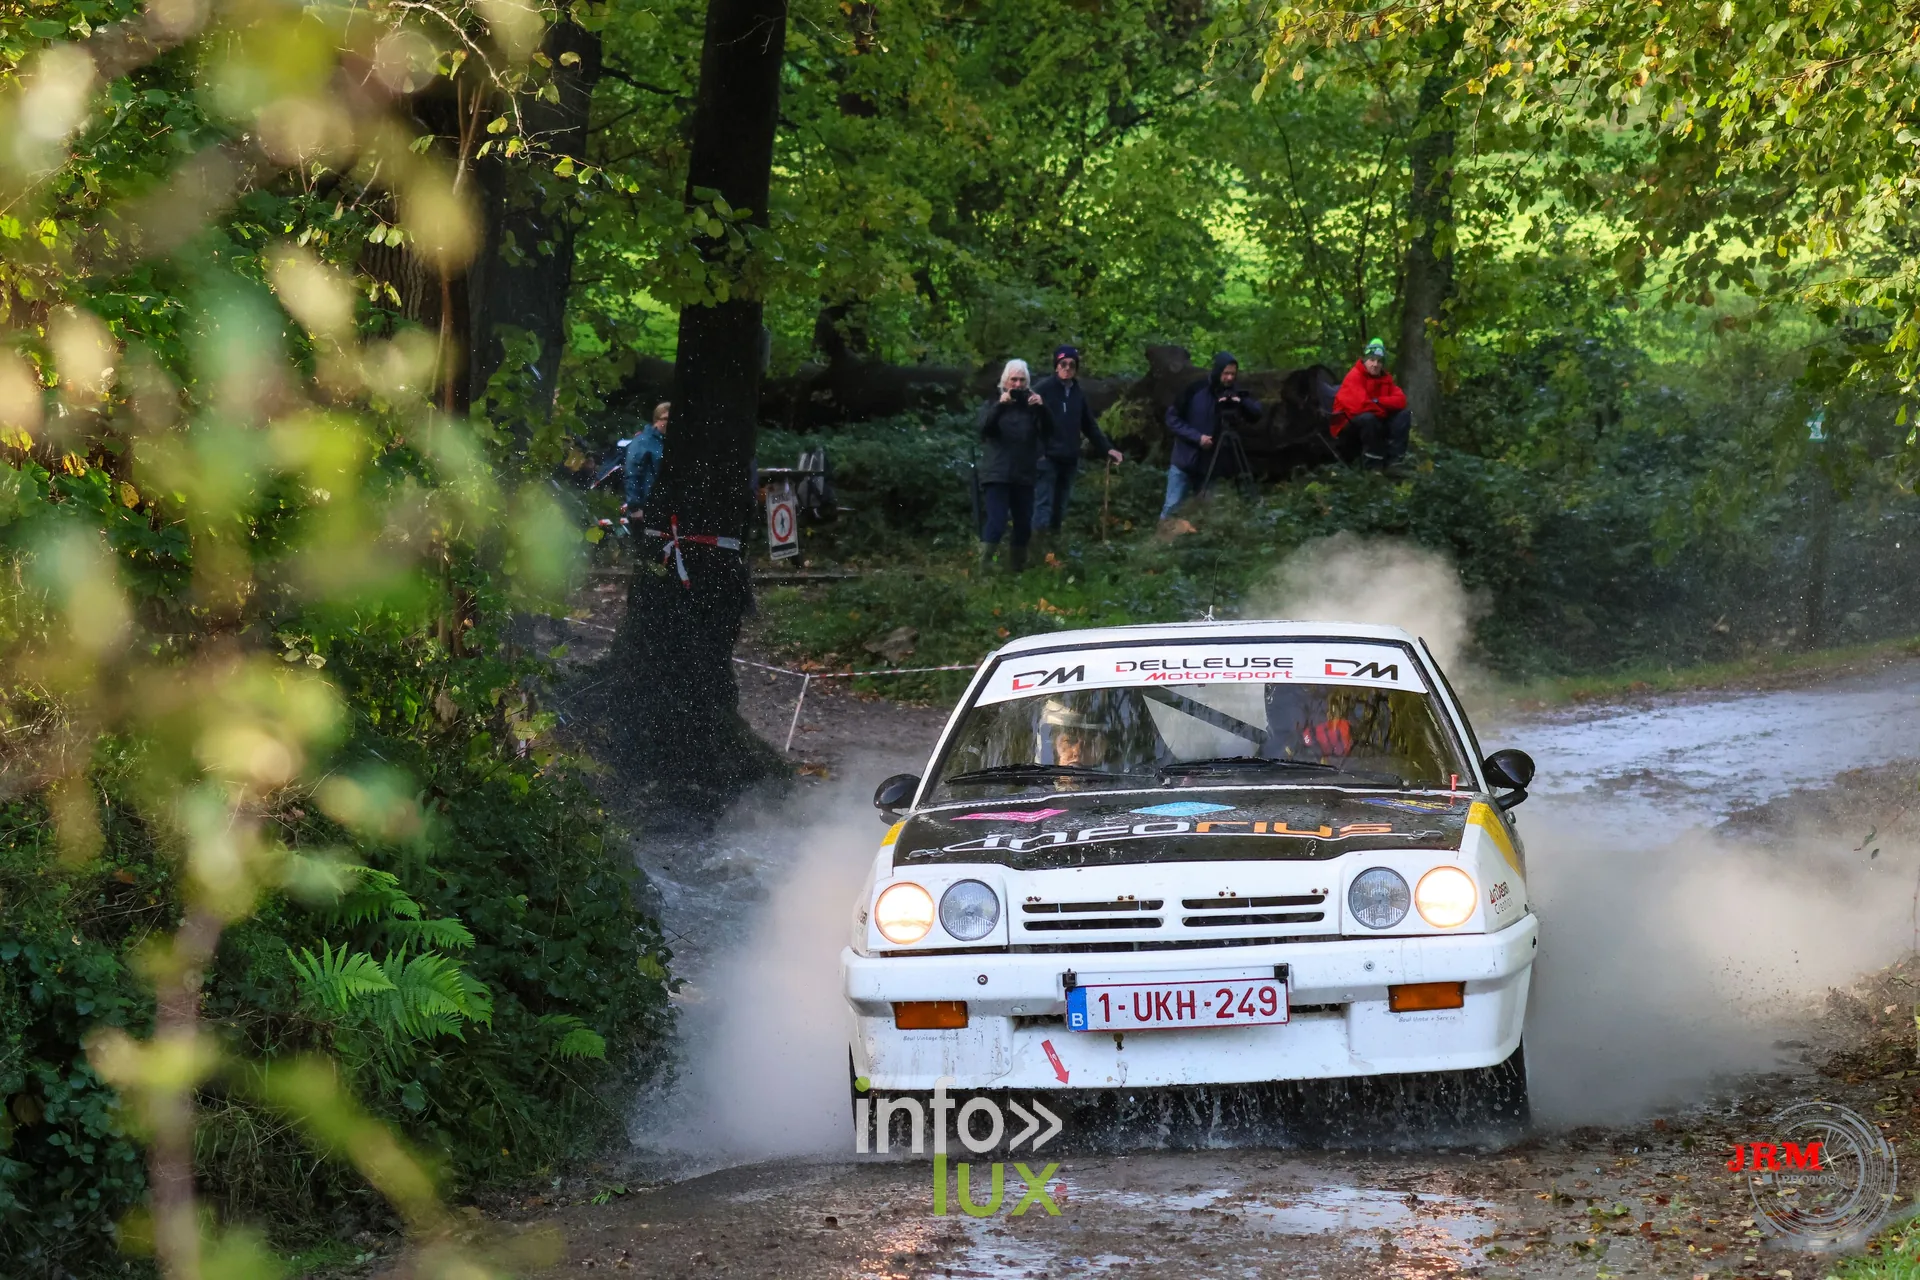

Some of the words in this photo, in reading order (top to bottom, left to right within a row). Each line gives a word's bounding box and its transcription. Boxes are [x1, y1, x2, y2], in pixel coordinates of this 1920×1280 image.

[1115, 657, 1294, 673] DELLEUSE
[1325, 658, 1398, 681] DM
[1012, 665, 1085, 690] DM
[1144, 670, 1293, 681] Motorsport
[1098, 985, 1278, 1023] 1-UKH-249
[1071, 1013, 1084, 1027] B
